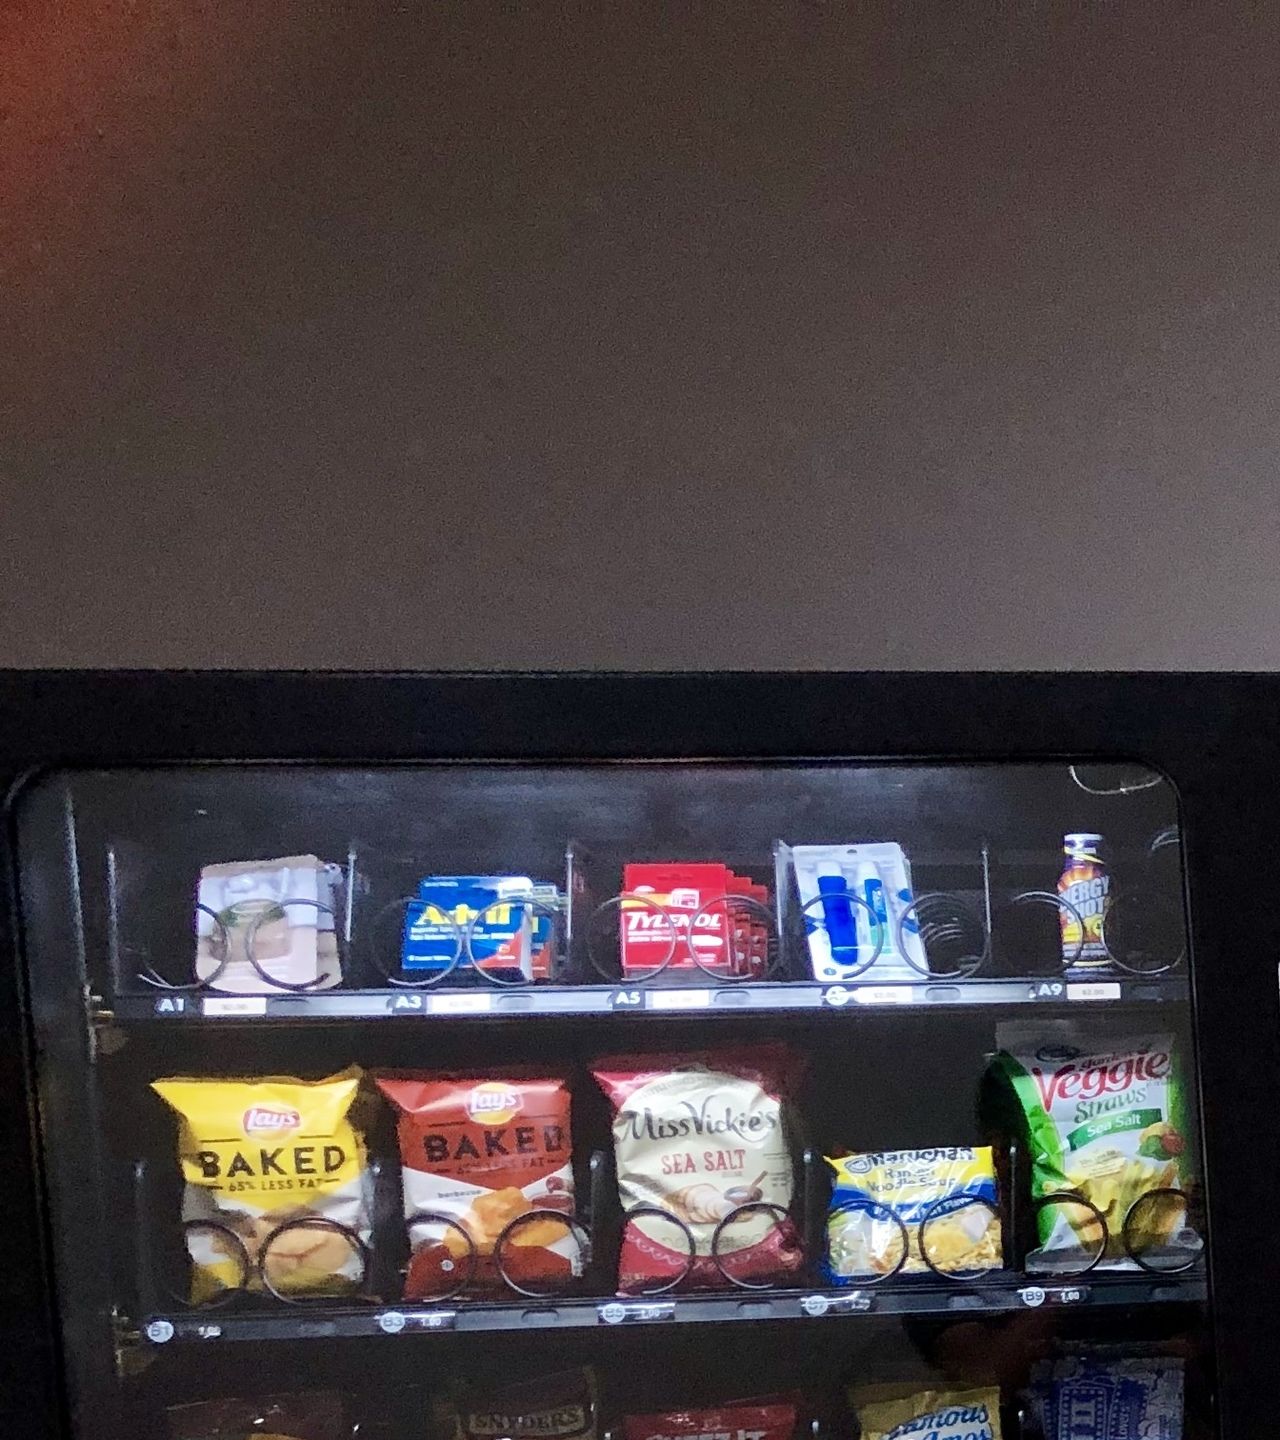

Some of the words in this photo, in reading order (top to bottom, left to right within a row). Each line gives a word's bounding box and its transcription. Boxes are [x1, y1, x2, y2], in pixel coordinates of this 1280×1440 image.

[627, 912, 722, 931] TYLENOL
[397, 994, 422, 1009] A3
[616, 991, 641, 1005] A5
[1038, 984, 1063, 997] A9
[158, 997, 186, 1013] A1
[1031, 1049, 1171, 1113] Veggie
[1073, 1086, 1148, 1125] Straws
[621, 1106, 690, 1142] Miss
[680, 1094, 778, 1142] Vickie's
[1086, 1120, 1113, 1139] Sea
[1114, 1113, 1142, 1130] Salt
[423, 1125, 565, 1163] BAKED
[200, 1145, 347, 1180] BAKED
[661, 1153, 697, 1176] SEA
[703, 1149, 747, 1172] SALT
[261, 1177, 295, 1191] LESS
[298, 1176, 323, 1190] FAT
[1025, 1289, 1044, 1303] B9
[1060, 1290, 1080, 1302] 1.00
